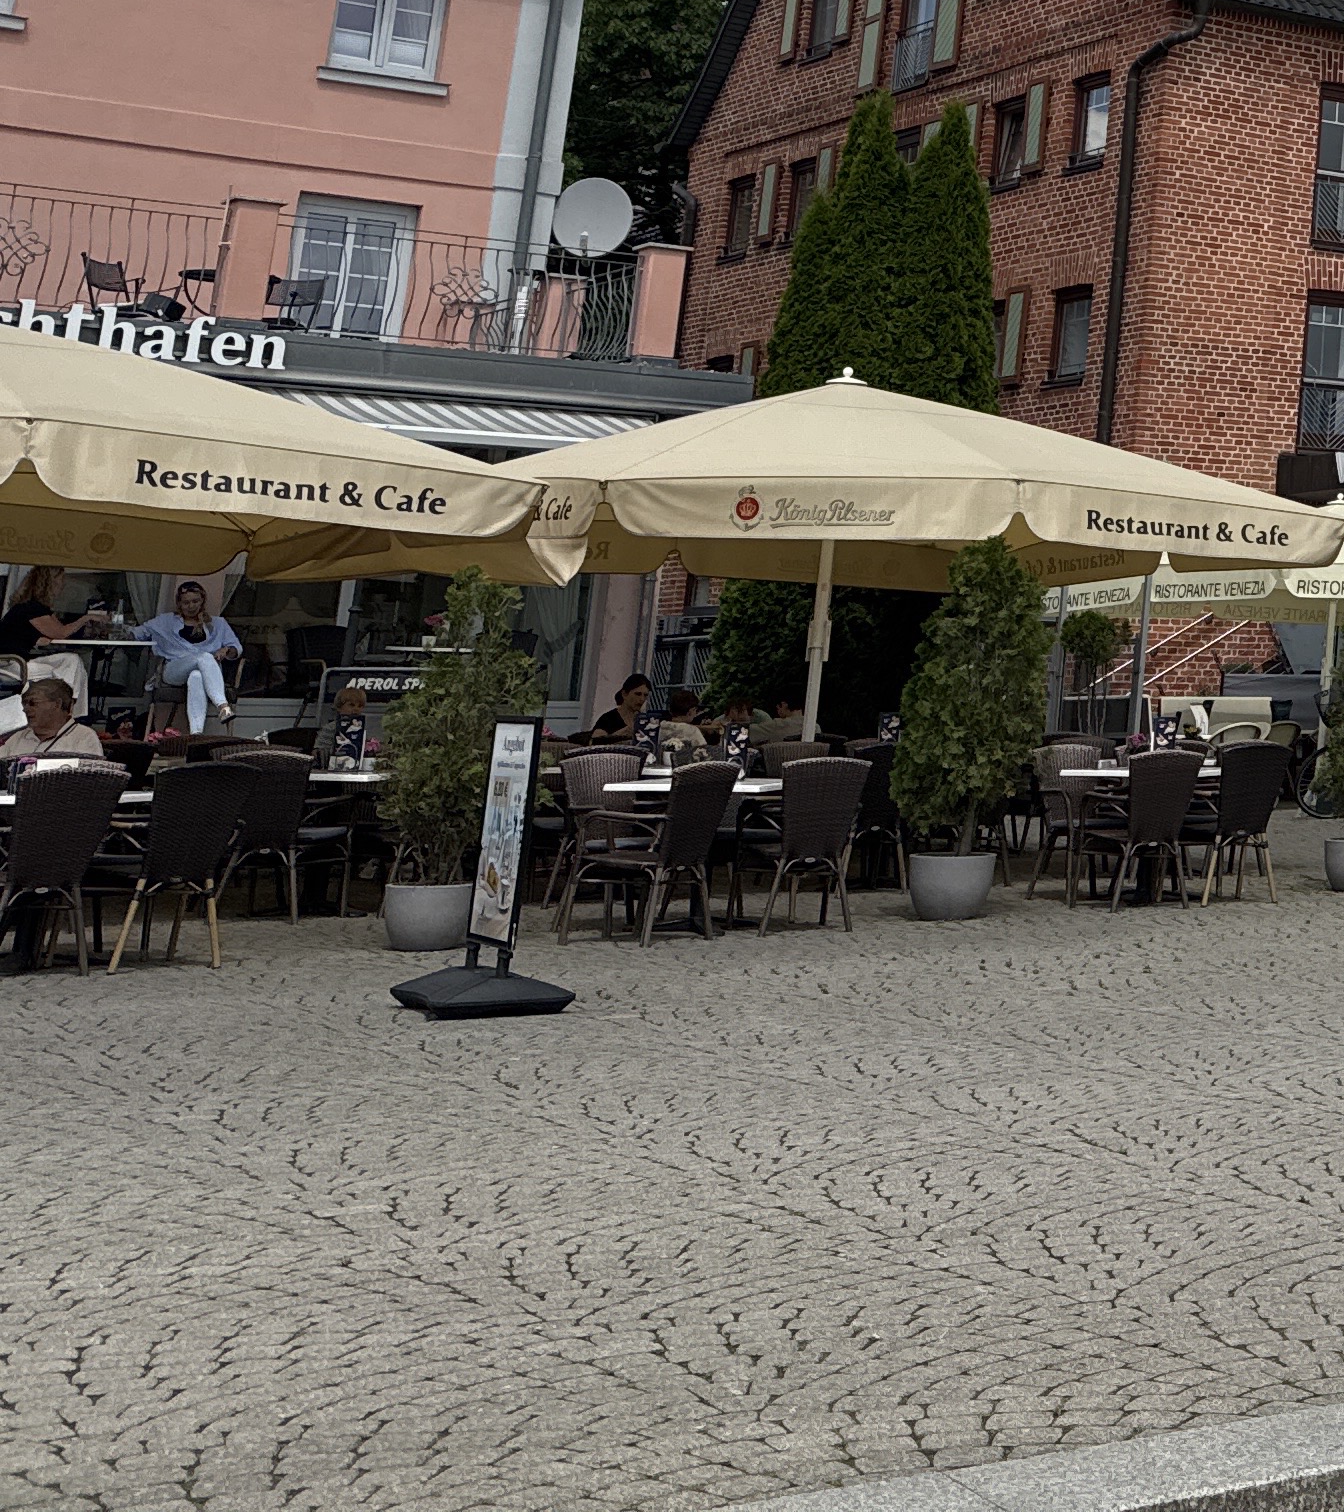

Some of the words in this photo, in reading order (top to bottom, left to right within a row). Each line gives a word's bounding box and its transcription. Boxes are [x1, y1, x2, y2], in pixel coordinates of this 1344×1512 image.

[135, 459, 330, 504] Restaurant
[338, 481, 363, 508] &
[374, 484, 447, 516] Cafe
[545, 495, 573, 521] Cafe
[769, 496, 829, 526] König
[826, 498, 896, 523] Pilsener
[1086, 509, 1210, 541] Restaurant
[1216, 521, 1234, 543] &
[1241, 523, 1289, 546] Cafe
[1093, 587, 1131, 605] VENEZIA
[1154, 583, 1215, 599] RISTORANTE
[1217, 580, 1266, 597] VENEZIA
[346, 677, 400, 691] APEROL
